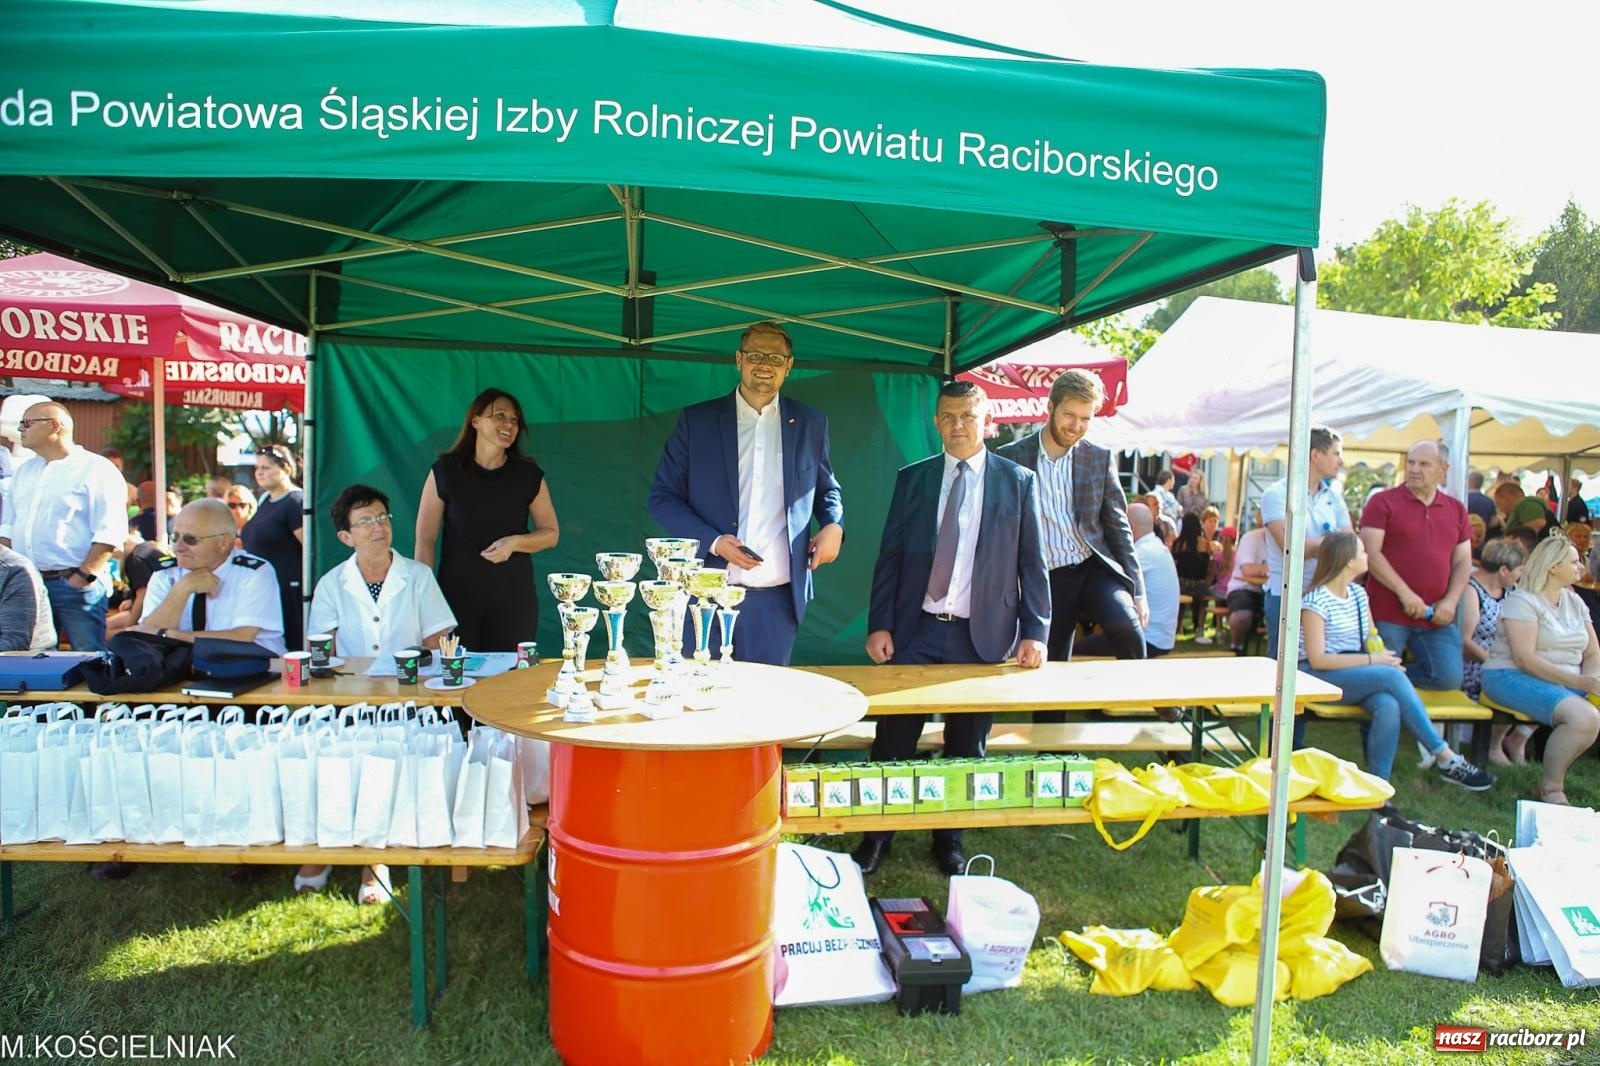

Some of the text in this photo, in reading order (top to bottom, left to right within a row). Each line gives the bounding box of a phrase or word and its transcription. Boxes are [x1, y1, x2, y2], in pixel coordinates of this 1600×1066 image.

[0, 86, 1218, 197] da Powiatowa Śląskiej Izby Rolniczej Powiatu Raciborskiego
[0, 306, 149, 345] ORSKIE
[1408, 934, 1469, 951] Ubezpieczenia
[1423, 929, 1456, 941] AGRO
[780, 940, 823, 957] PRACUJ
